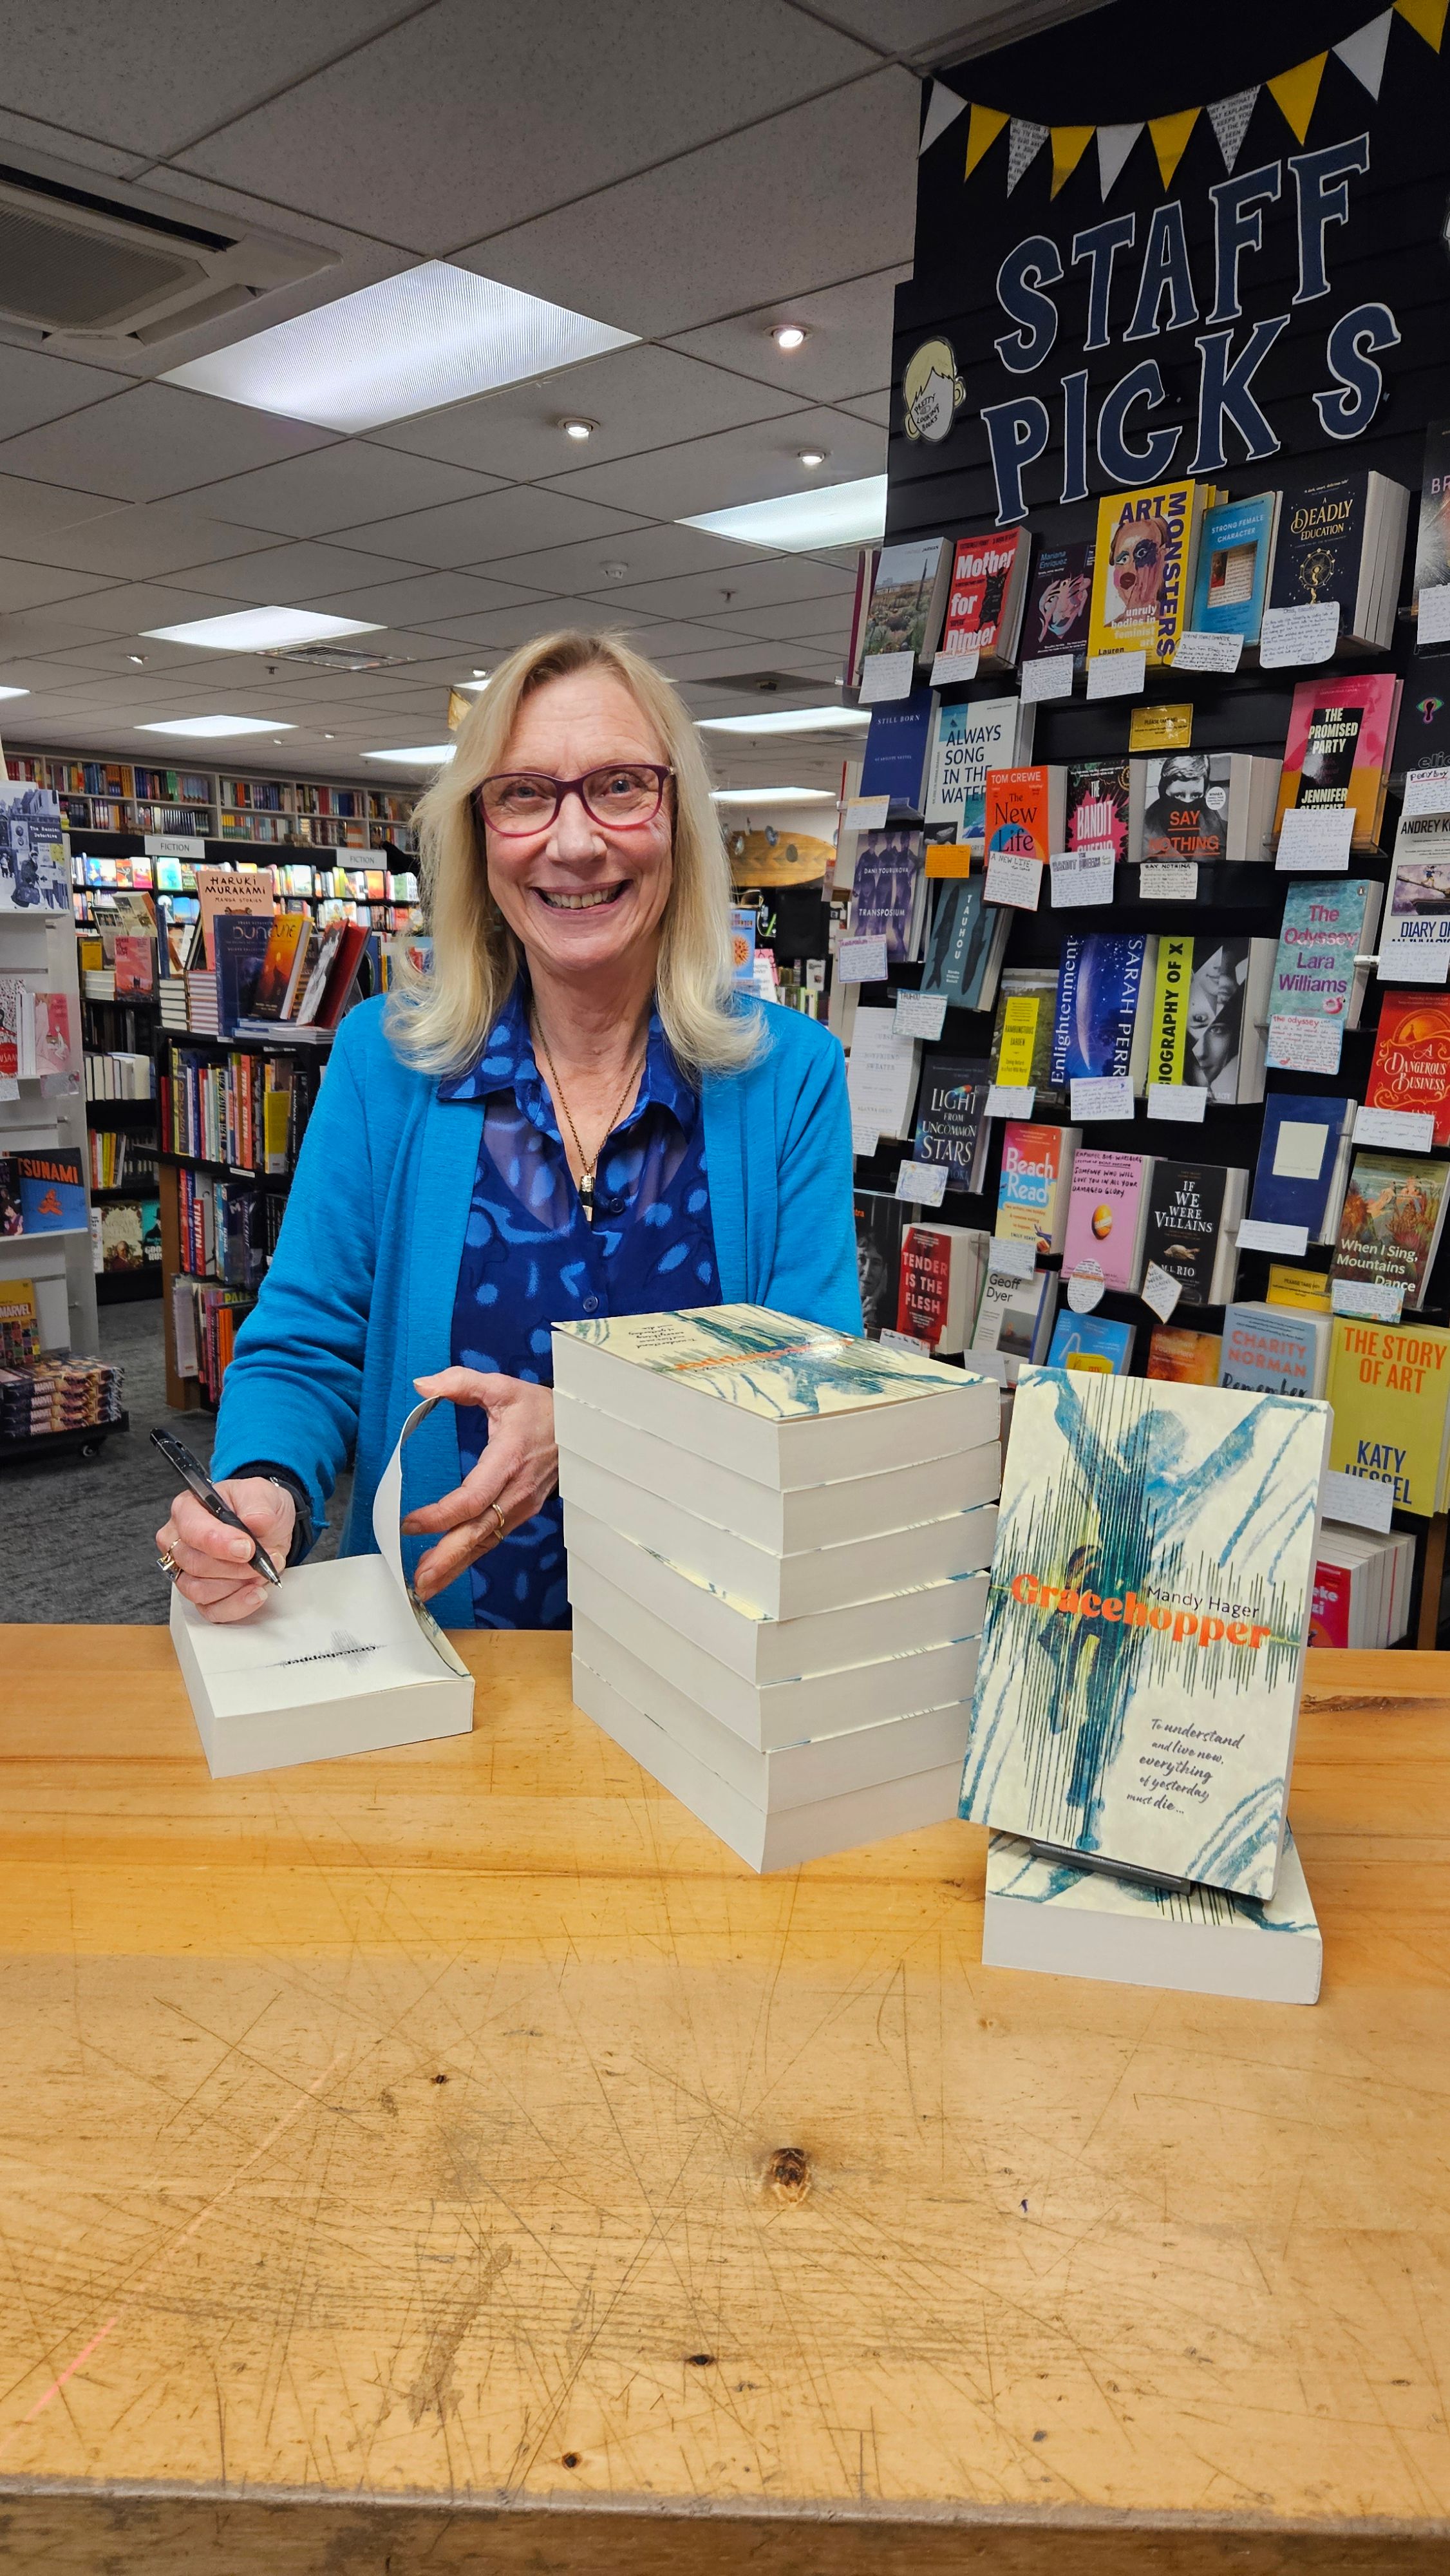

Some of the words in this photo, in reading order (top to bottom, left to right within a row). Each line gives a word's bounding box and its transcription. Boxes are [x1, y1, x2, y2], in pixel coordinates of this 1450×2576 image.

[994, 131, 1370, 374] STAFF
[914, 393, 936, 415] PRETTY
[917, 404, 940, 424] LOOKING
[922, 415, 937, 431] BOOKS
[981, 303, 1401, 526] PICKS
[1118, 495, 1165, 525] ART
[1291, 498, 1353, 534] DEADLY
[1211, 519, 1238, 534] STRONG
[1239, 514, 1265, 527] FEMALE
[1301, 523, 1344, 541] EDUCATION
[1217, 527, 1256, 543] CHARACTER
[956, 549, 1015, 579] Mother
[1156, 491, 1187, 656] MONSTERS
[950, 593, 977, 617] for
[1126, 604, 1156, 616] unruly
[1111, 616, 1144, 629] bodies
[1146, 615, 1156, 624] in
[946, 625, 996, 653] Dinner
[1114, 626, 1154, 639] feminist
[1098, 646, 1124, 656] Lauren
[878, 716, 898, 724] STILL
[1325, 708, 1343, 721] THE
[946, 724, 1001, 747] ALWAYS
[1308, 723, 1359, 739] PROMISED
[945, 746, 984, 766] SONG
[1312, 739, 1346, 754] PARTY
[943, 768, 959, 785] IN
[991, 775, 1008, 784] TOM
[1010, 772, 1041, 783] CREWE
[1009, 793, 1023, 802] The
[1091, 781, 1100, 798] THE
[1301, 788, 1348, 804] JENNIFER
[995, 802, 1038, 824] New
[1077, 800, 1113, 840] BANDIT
[1169, 810, 1200, 826] SAY
[1401, 819, 1440, 835] ANDREY
[160, 843, 190, 852] FICTION
[999, 828, 1033, 852] Life
[1149, 835, 1219, 851] NOTHING
[350, 856, 375, 864] FICTION
[998, 856, 1013, 864] NEW
[205, 886, 266, 895] MURAKAMI
[210, 876, 256, 886] HARUKI
[859, 908, 905, 916] TRANSPOSIUM
[1309, 905, 1339, 923] The
[954, 895, 972, 959] TAUHOU
[1400, 922, 1436, 938] DIARY
[1285, 928, 1357, 948] Odyssey
[1169, 942, 1183, 956] X
[1297, 952, 1335, 969] Lara
[1120, 940, 1142, 1014] SARAH
[1167, 960, 1181, 983] OF
[1279, 974, 1347, 992] Williams
[1051, 938, 1078, 1083] Enlightenment
[1288, 1016, 1319, 1028] odyssey
[1113, 1023, 1131, 1077] PERR
[1384, 1052, 1446, 1075] DANGEROUS
[1392, 1070, 1445, 1094] BUSINESS
[930, 1088, 977, 1115] LIGHT
[943, 1113, 964, 1122] FROM
[923, 1120, 977, 1138] UNCOMMON
[921, 1135, 972, 1166] STARS
[17, 1157, 79, 1184] TSUNAMI
[1006, 1148, 1053, 1179] Beach
[1075, 1167, 1101, 1175] SOMEONE
[1008, 1173, 1048, 1204] Read
[1105, 1188, 1124, 1198] GLORY
[1183, 1180, 1195, 1191] IF
[1174, 1191, 1200, 1208] WE
[1154, 1211, 1213, 1233] VILLAINS
[1169, 1206, 1202, 1220] WERE
[194, 1203, 203, 1249] TINTIN
[1341, 1238, 1378, 1255] When
[1381, 1244, 1385, 1255] I
[1387, 1245, 1418, 1262] Sing,
[903, 1251, 948, 1276] TENDER
[1177, 1265, 1194, 1276] RIO
[1337, 1253, 1406, 1274] Mountains
[905, 1273, 916, 1287] IS
[920, 1276, 943, 1295] THE
[989, 1273, 1021, 1290] Geoff
[1374, 1275, 1416, 1292] Dance
[905, 1292, 941, 1315] FLESH
[986, 1287, 1013, 1303] Dyer
[1232, 1330, 1307, 1359] CHARITY
[1344, 1327, 1379, 1356] THE
[1382, 1334, 1448, 1371] STORY
[1228, 1347, 1307, 1378] NORMAN
[1359, 1358, 1383, 1385] OF
[1386, 1365, 1427, 1394] ART
[1357, 1440, 1407, 1472] KATY
[1012, 1573, 1271, 1649] Gracehopper
[1146, 1586, 1203, 1610] Mandy
[1209, 1597, 1259, 1619] Hager
[1152, 1718, 1162, 1730] To
[1163, 1723, 1245, 1749] understand
[1151, 1741, 1172, 1752] and
[1172, 1740, 1195, 1756] live
[1198, 1752, 1224, 1765] now,
[1139, 1756, 1213, 1785] everything
[1127, 1793, 1153, 1804] must
[1140, 1775, 1151, 1787] of
[1149, 1778, 1209, 1803] yesterday
